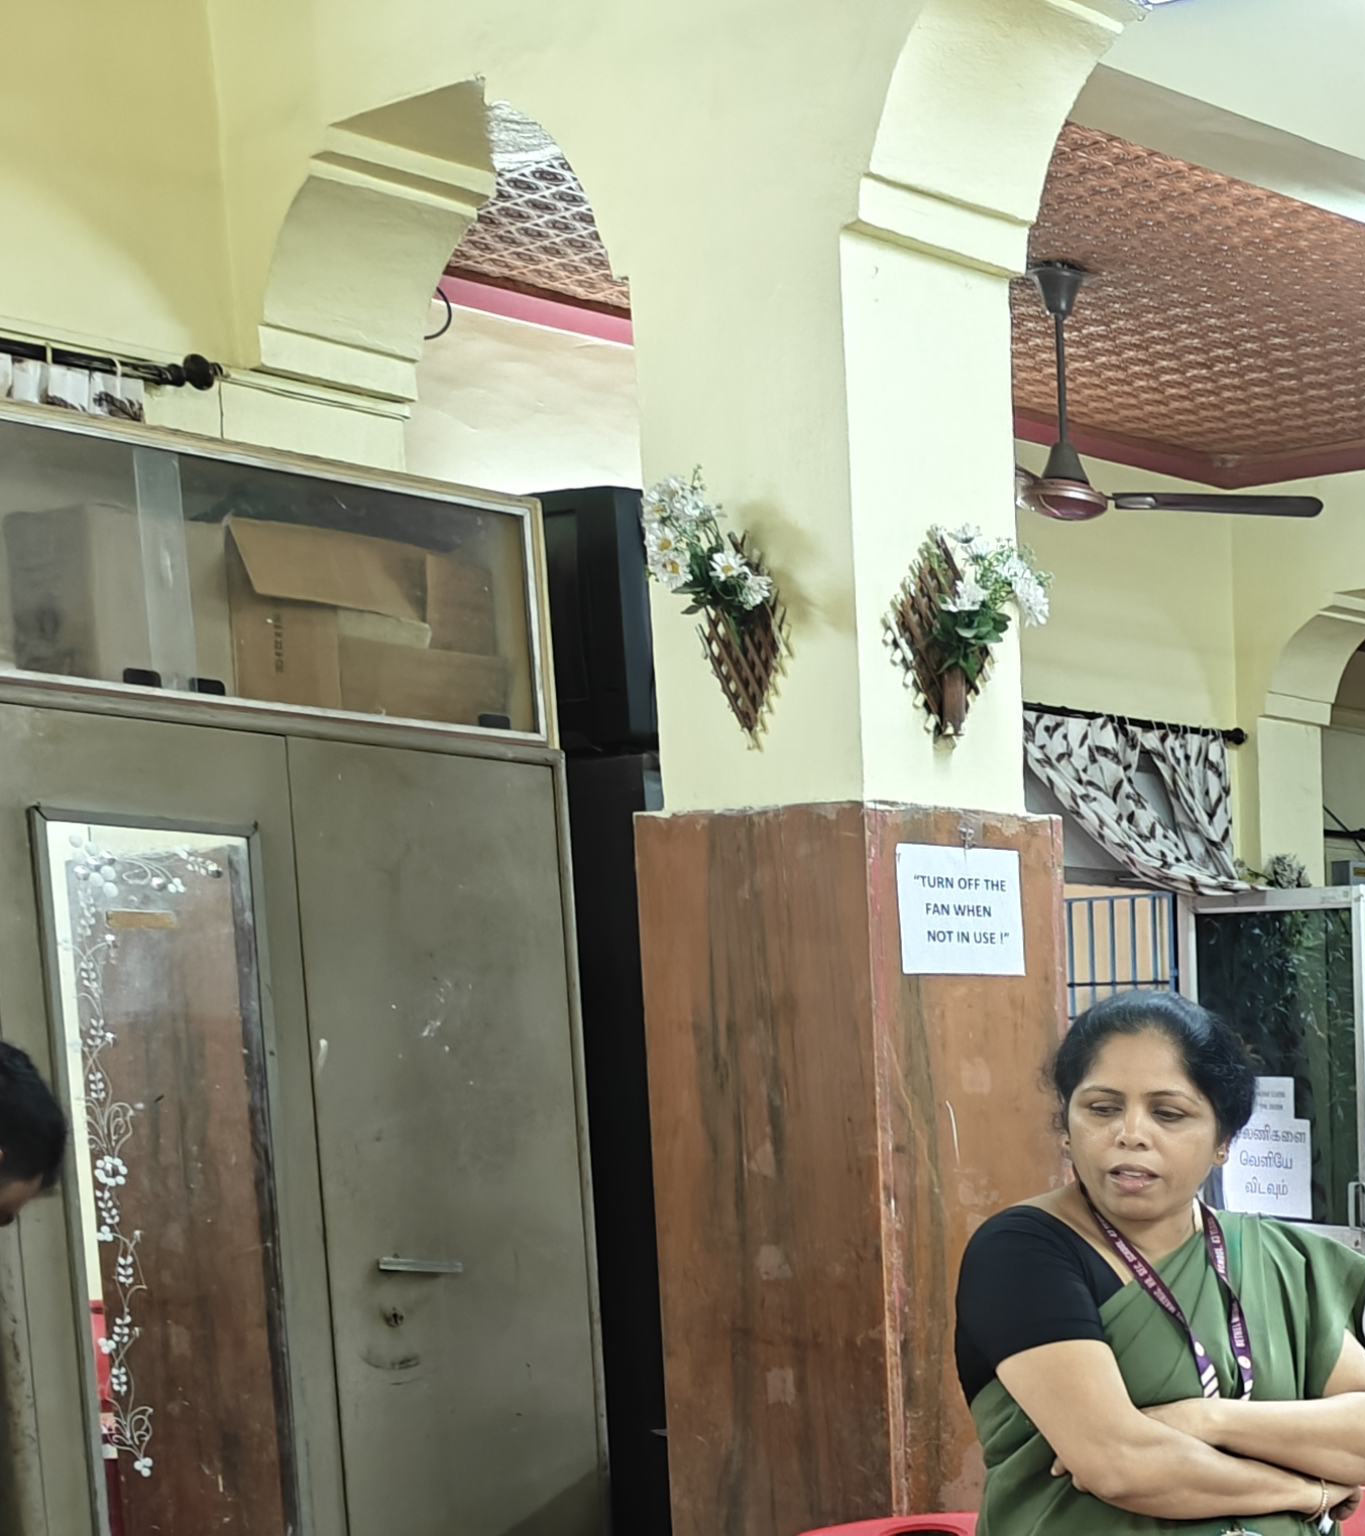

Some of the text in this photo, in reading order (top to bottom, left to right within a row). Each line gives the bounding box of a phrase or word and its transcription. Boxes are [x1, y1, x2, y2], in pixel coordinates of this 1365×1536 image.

[958, 877, 980, 890] OFF
[984, 879, 1006, 892] THE
[925, 903, 992, 917] FAN WHEN
[927, 930, 953, 943] NOT
[957, 931, 970, 943] IN
[974, 932, 996, 944] USE
[1235, 1124, 1306, 1143] லணிகளை
